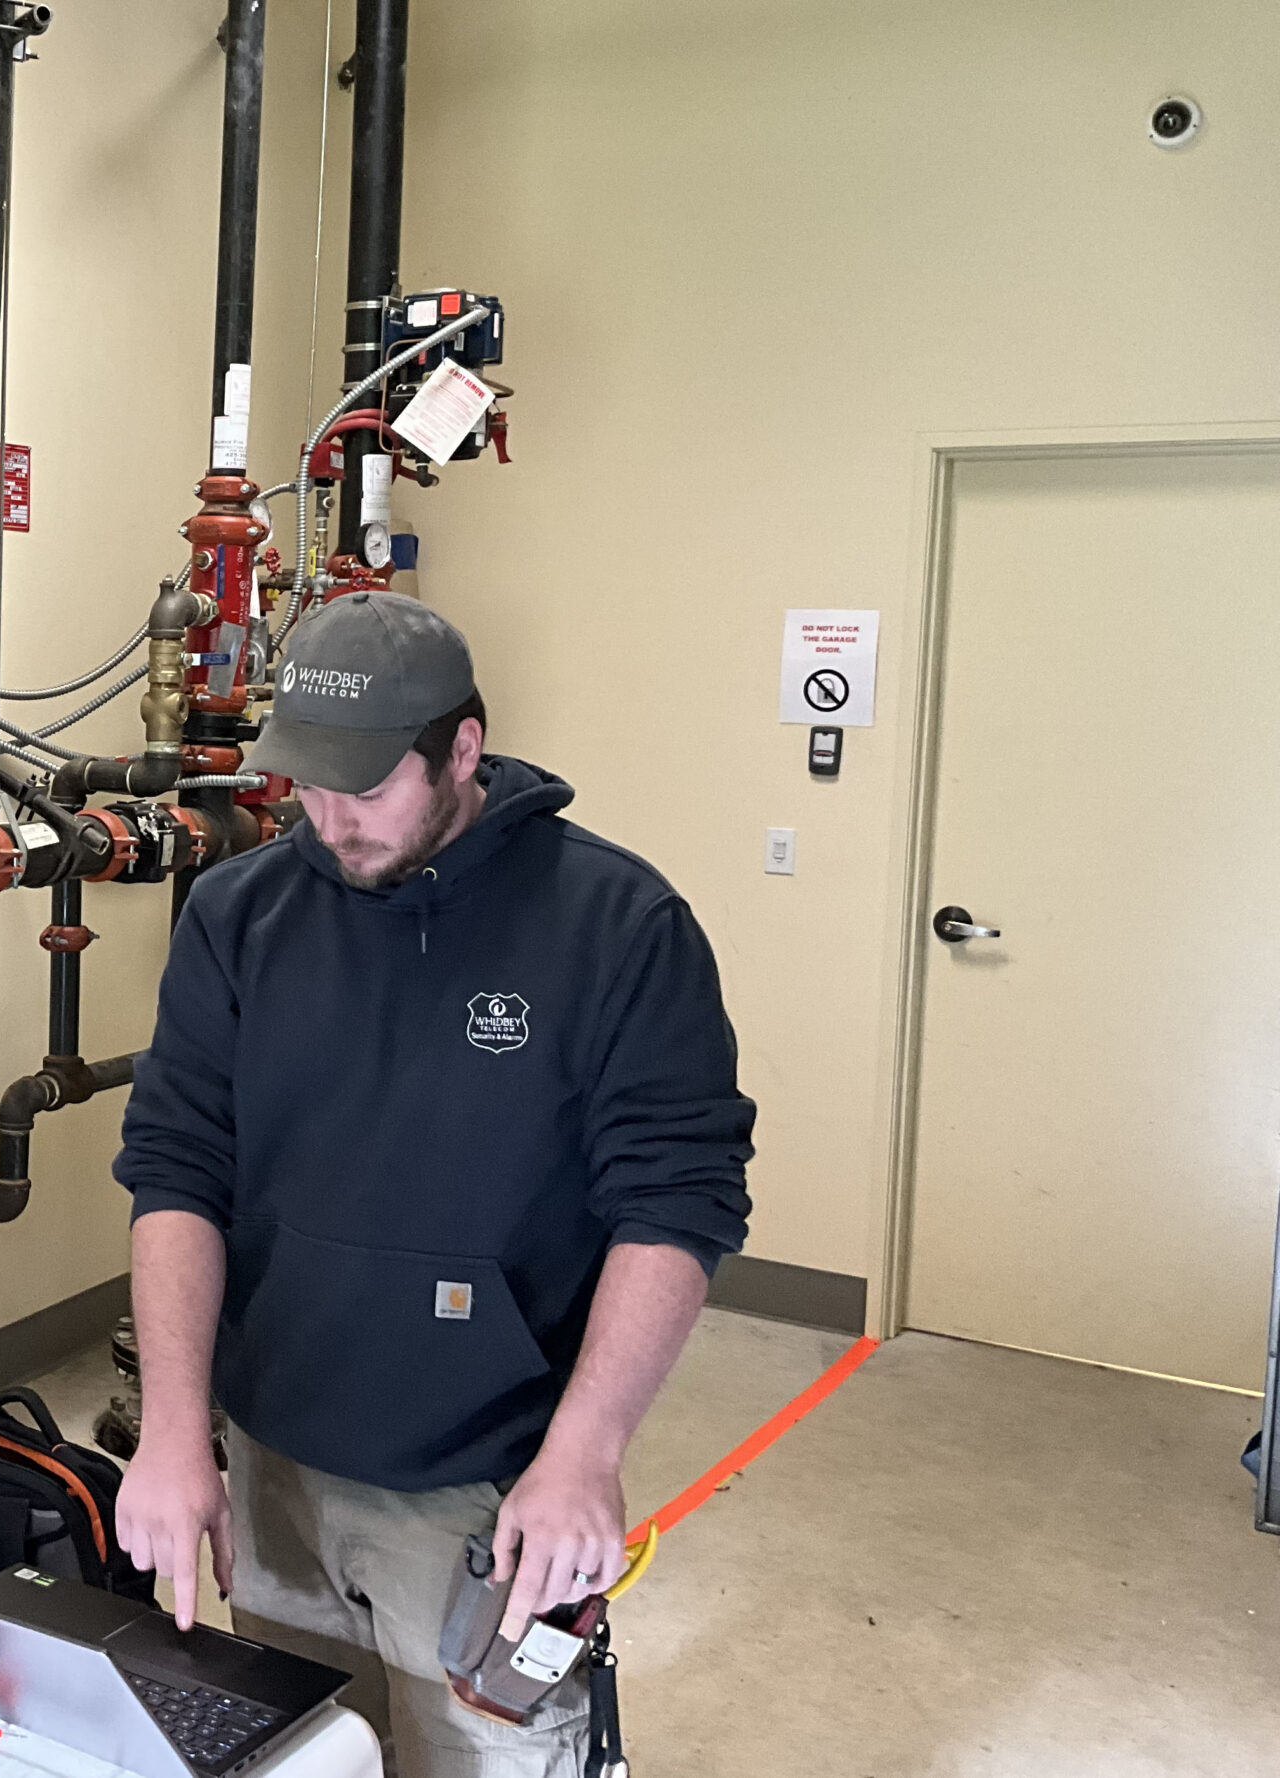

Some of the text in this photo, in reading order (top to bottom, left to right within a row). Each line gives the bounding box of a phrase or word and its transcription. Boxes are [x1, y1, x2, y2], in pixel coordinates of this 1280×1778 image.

[300, 667, 373, 690] WHIDBEY
[302, 684, 359, 699] TELECOM
[475, 1016, 520, 1027] WHIDBEY
